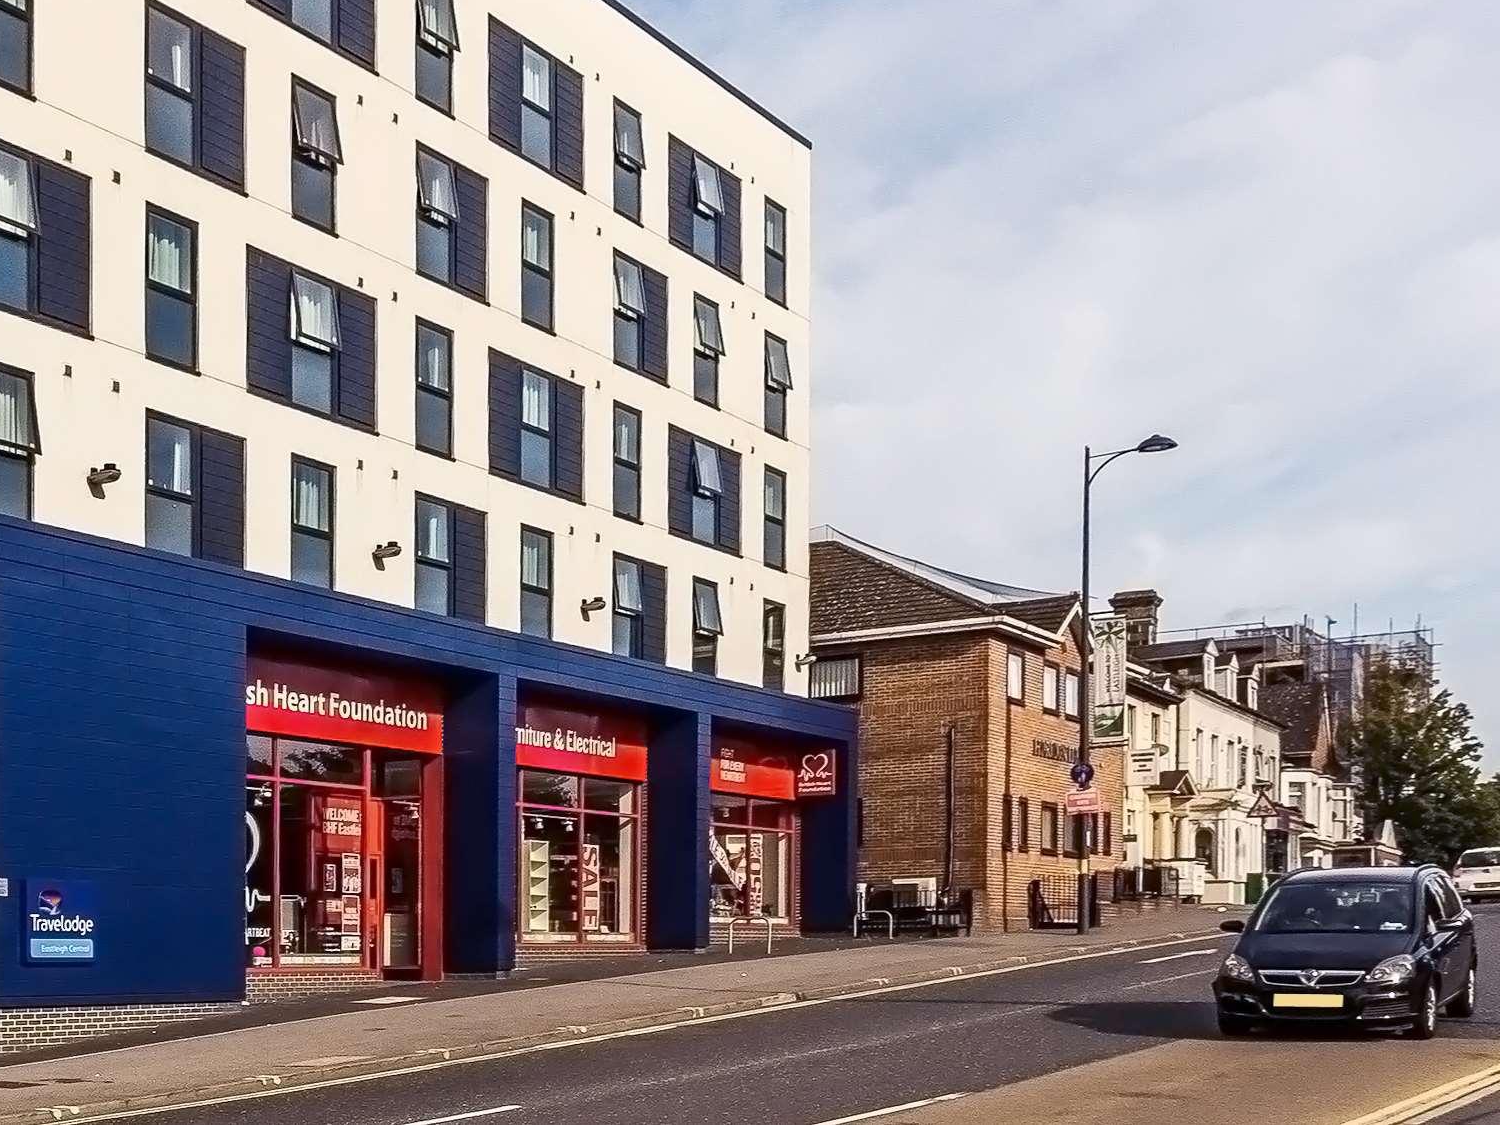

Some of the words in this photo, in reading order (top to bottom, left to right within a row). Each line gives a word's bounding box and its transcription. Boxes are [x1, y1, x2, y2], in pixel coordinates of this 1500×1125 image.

[273, 683, 325, 716] Heart
[329, 692, 428, 731] Foundation
[553, 728, 565, 751] &
[566, 729, 616, 758] Electrical
[323, 808, 360, 823] WELCOME
[583, 846, 599, 929] SALE
[29, 914, 94, 936] Travelodge
